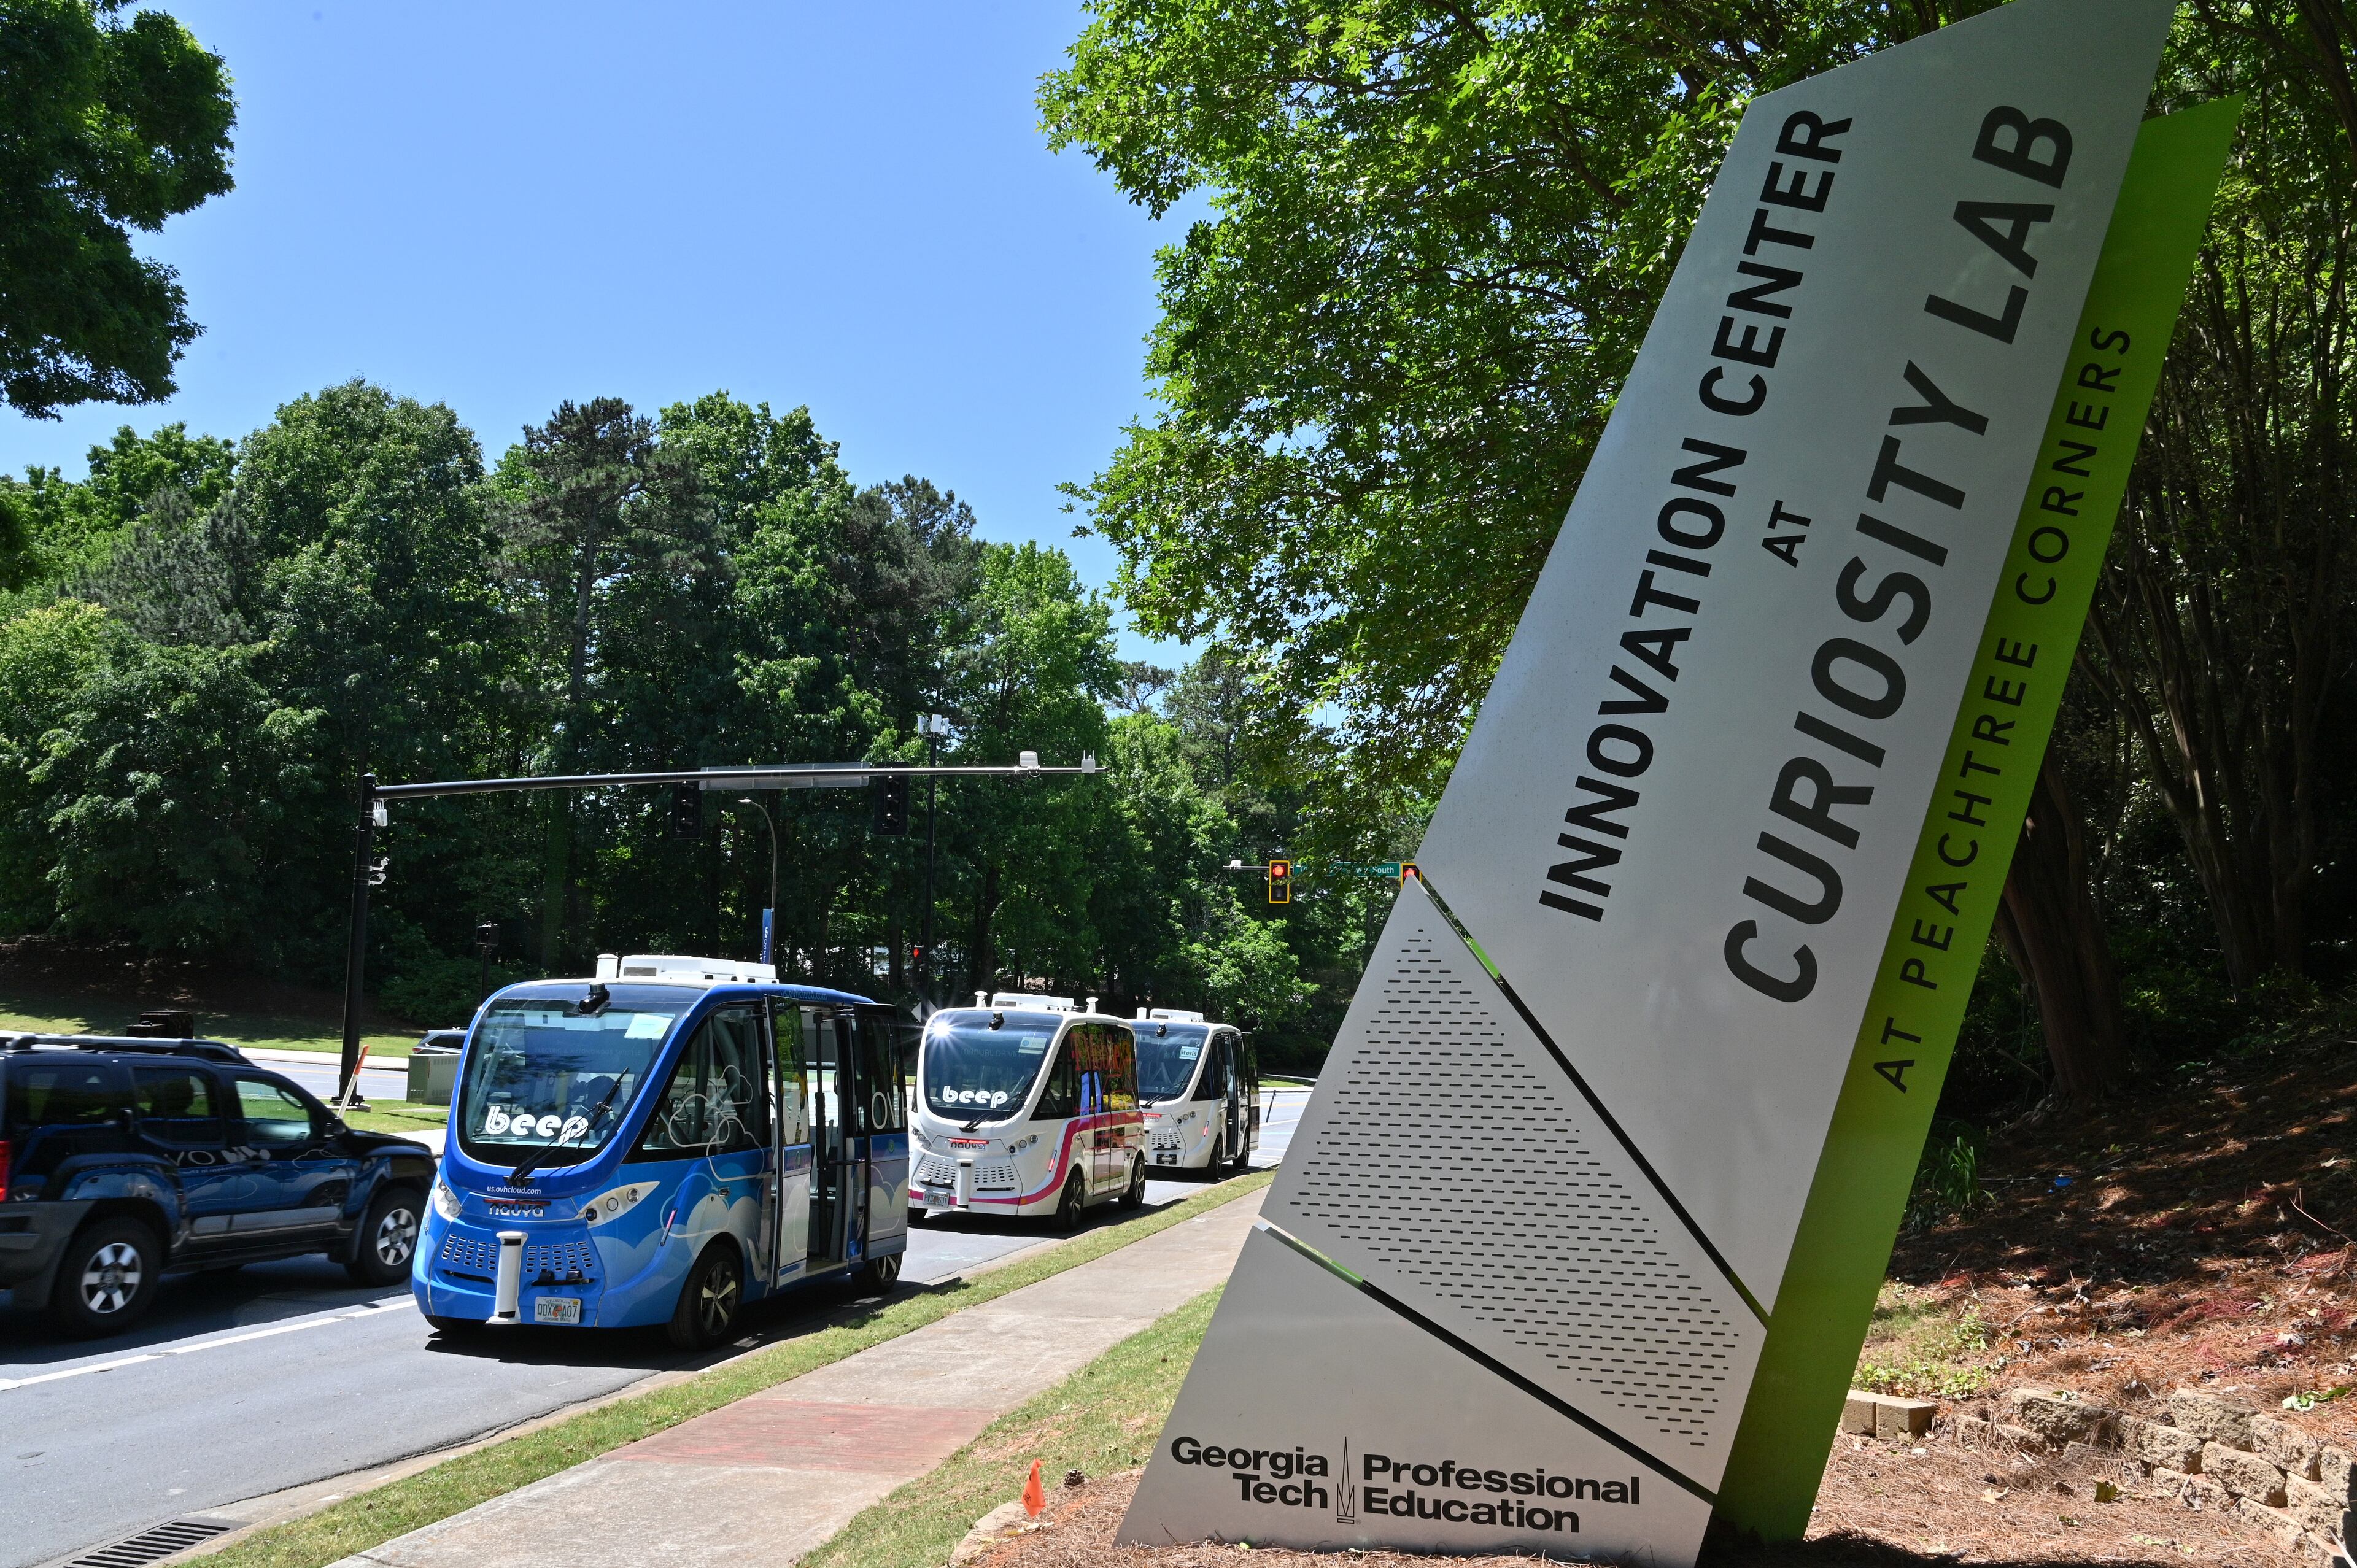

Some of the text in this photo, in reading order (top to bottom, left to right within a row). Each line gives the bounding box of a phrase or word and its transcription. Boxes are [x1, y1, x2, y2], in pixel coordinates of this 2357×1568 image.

[1539, 110, 1853, 922] INNOVATION CENTER
[1761, 500, 1812, 568] AT
[1724, 105, 2073, 1003] CURIOSITY LAB
[1873, 326, 2131, 1093] AT PEACHTREE CORNERS
[780, 988, 828, 1000] us.ovhcloud.com
[942, 1085, 1008, 1108] beep
[484, 1106, 589, 1144] beep
[487, 1186, 541, 1195] us.ovhcloud.com
[1171, 1436, 1328, 1479] Georgia
[1363, 1453, 1640, 1505] Professional
[1232, 1473, 1328, 1509] Tech
[1363, 1487, 1579, 1533] Education
